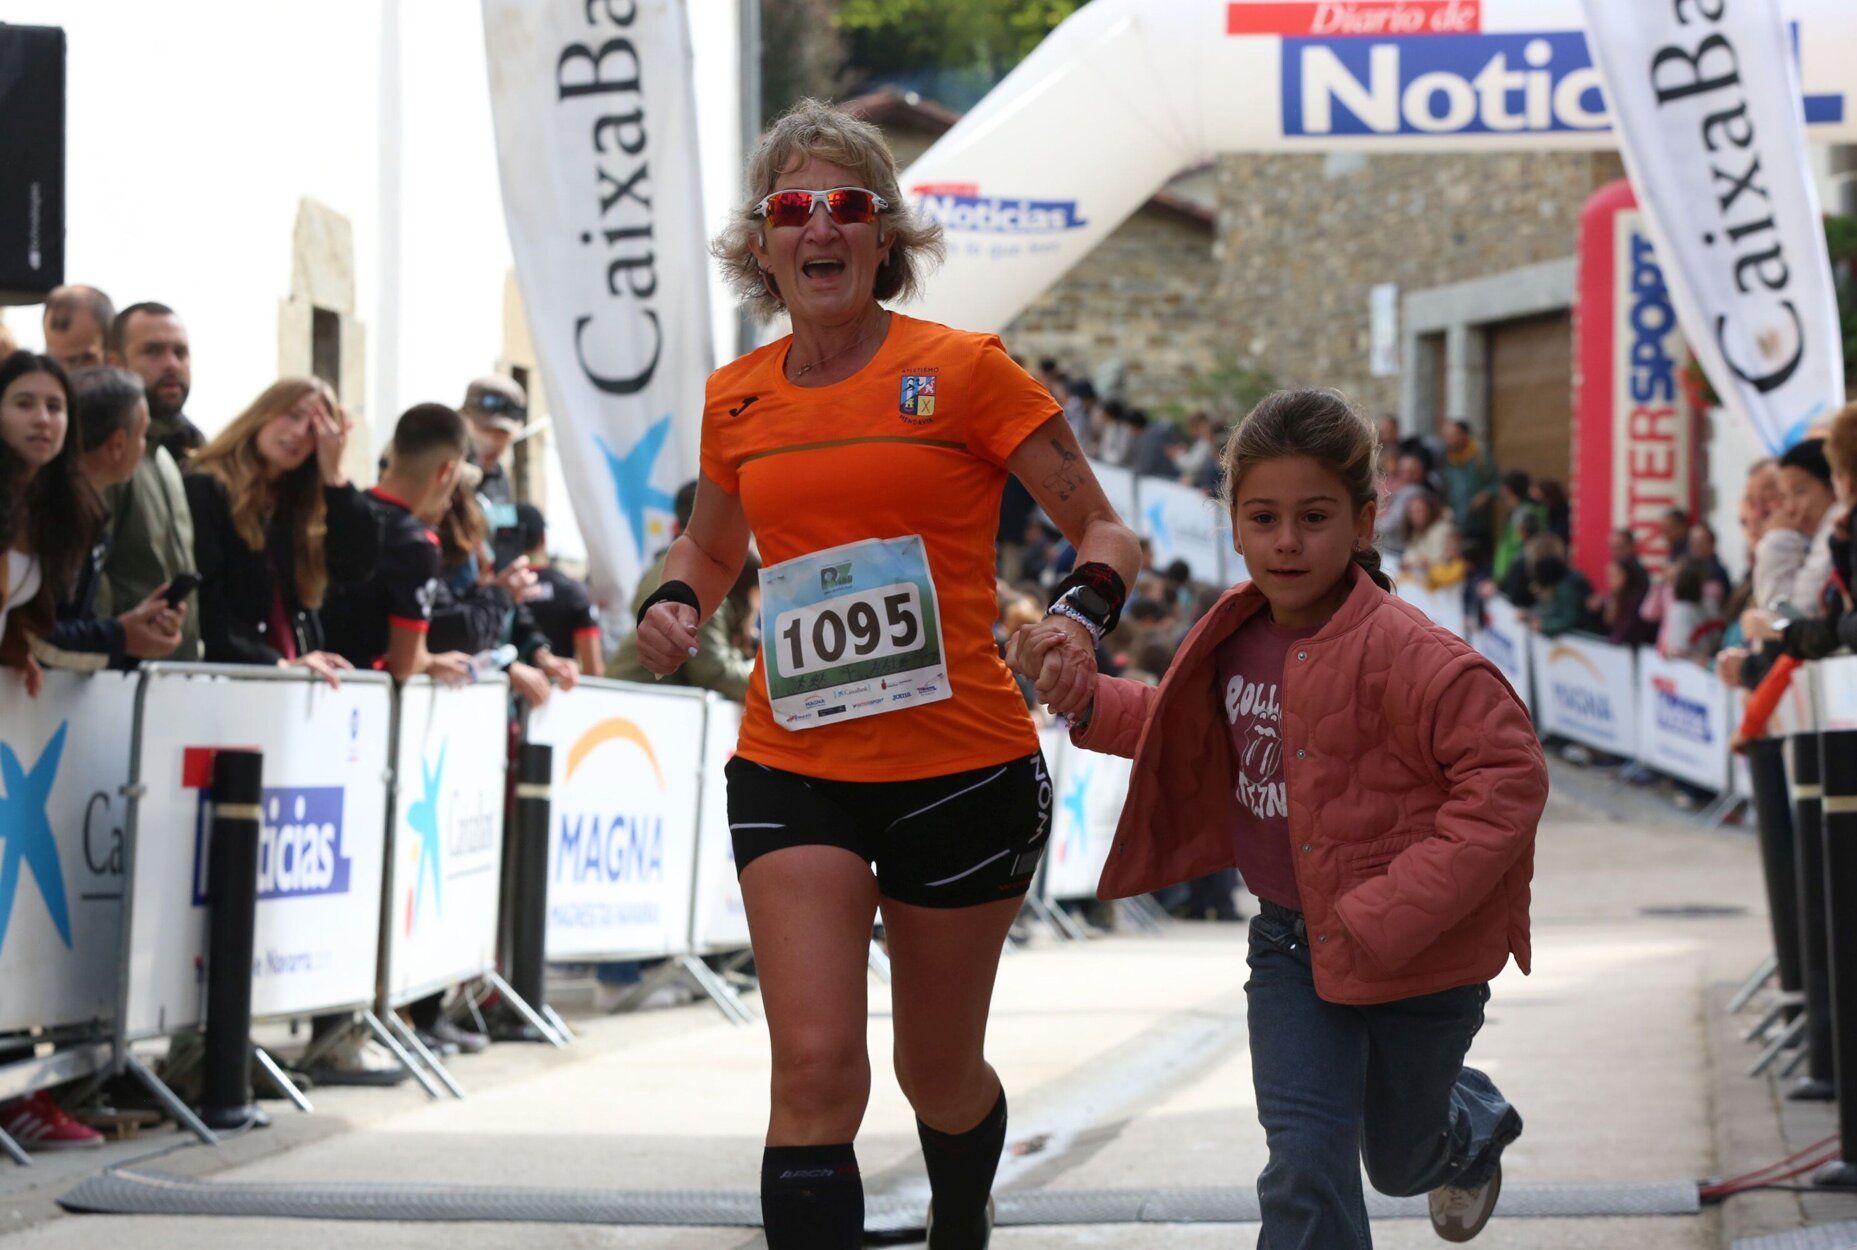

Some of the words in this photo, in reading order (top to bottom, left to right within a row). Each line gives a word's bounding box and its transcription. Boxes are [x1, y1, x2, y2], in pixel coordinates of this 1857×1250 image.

[1309, 2, 1423, 34] Diario
[1430, 4, 1477, 33] de
[783, 592, 918, 670] 1095
[556, 811, 664, 882] MAGNA
